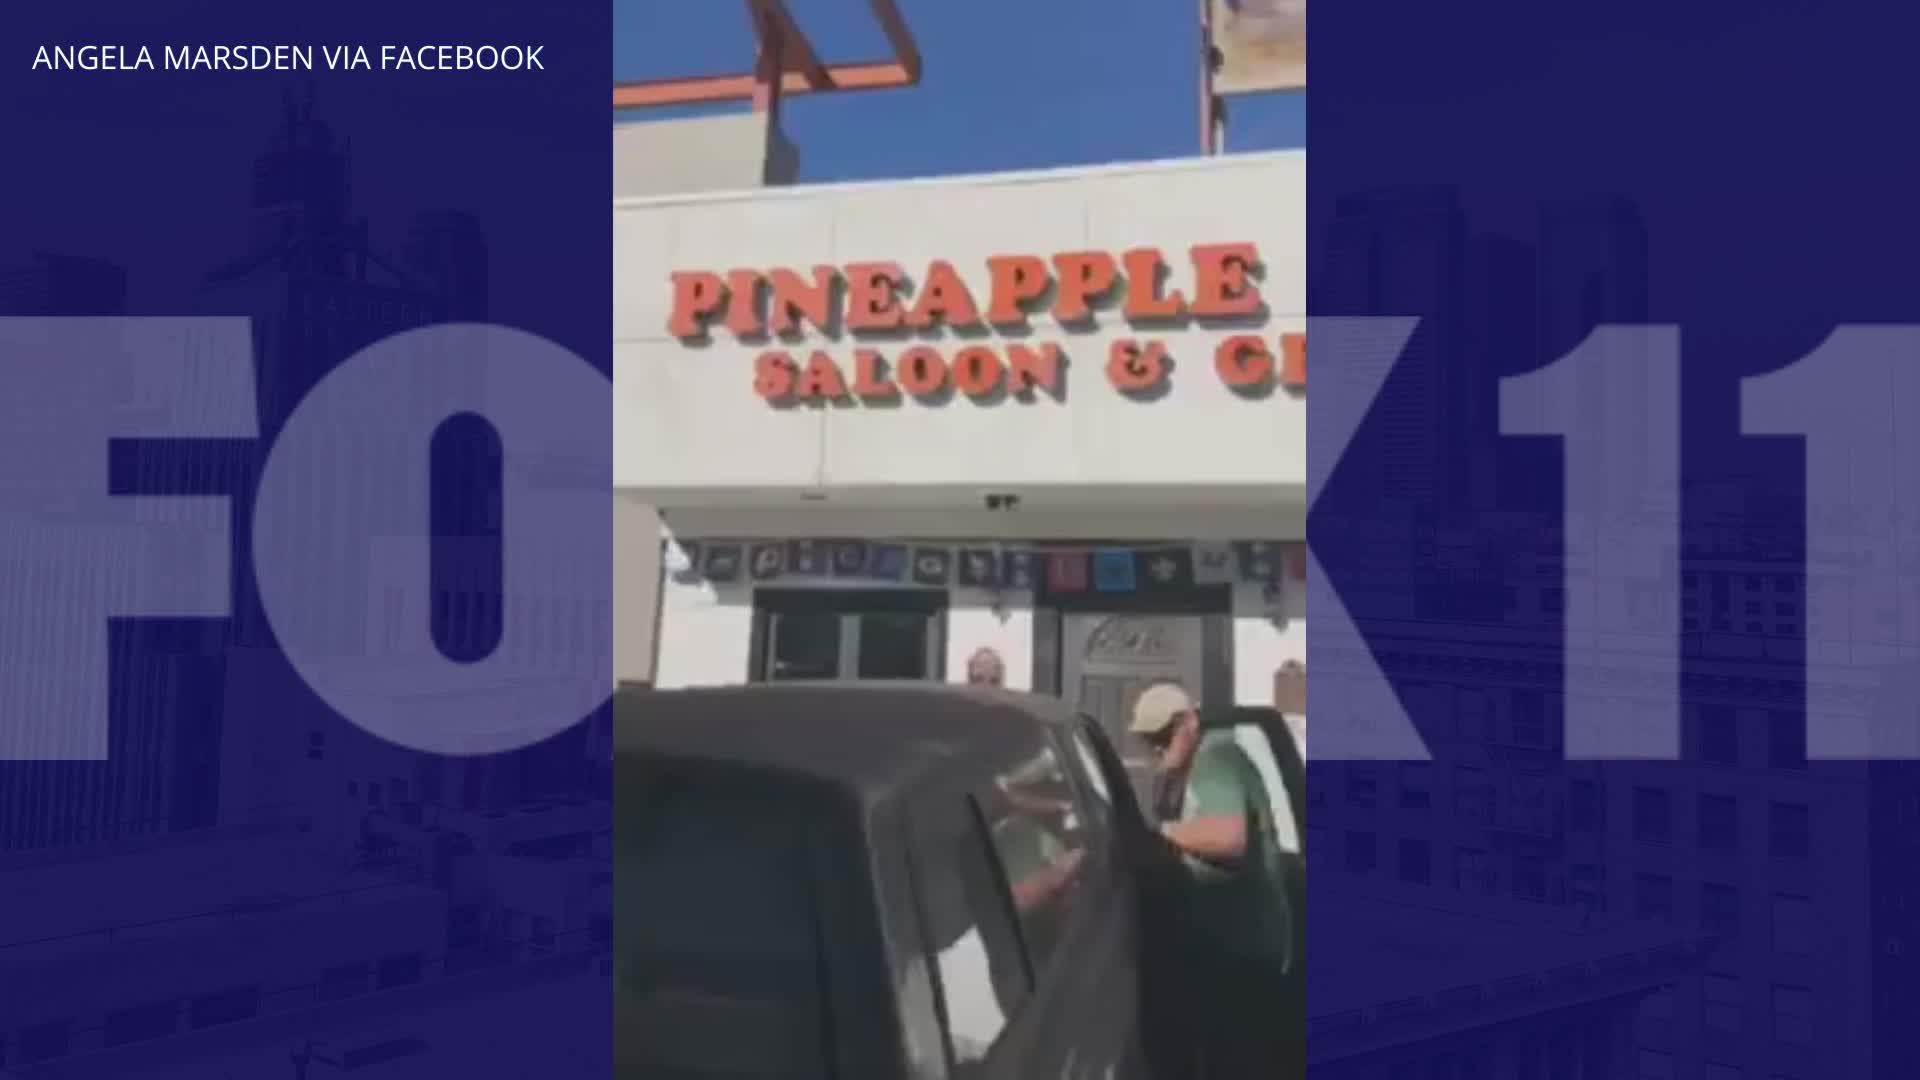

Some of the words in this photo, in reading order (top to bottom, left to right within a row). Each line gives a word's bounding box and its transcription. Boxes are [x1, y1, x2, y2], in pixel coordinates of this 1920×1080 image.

[668, 243, 1262, 342] PINEAPPLE
[754, 344, 1060, 402] SALOON
[1106, 340, 1170, 397] &
